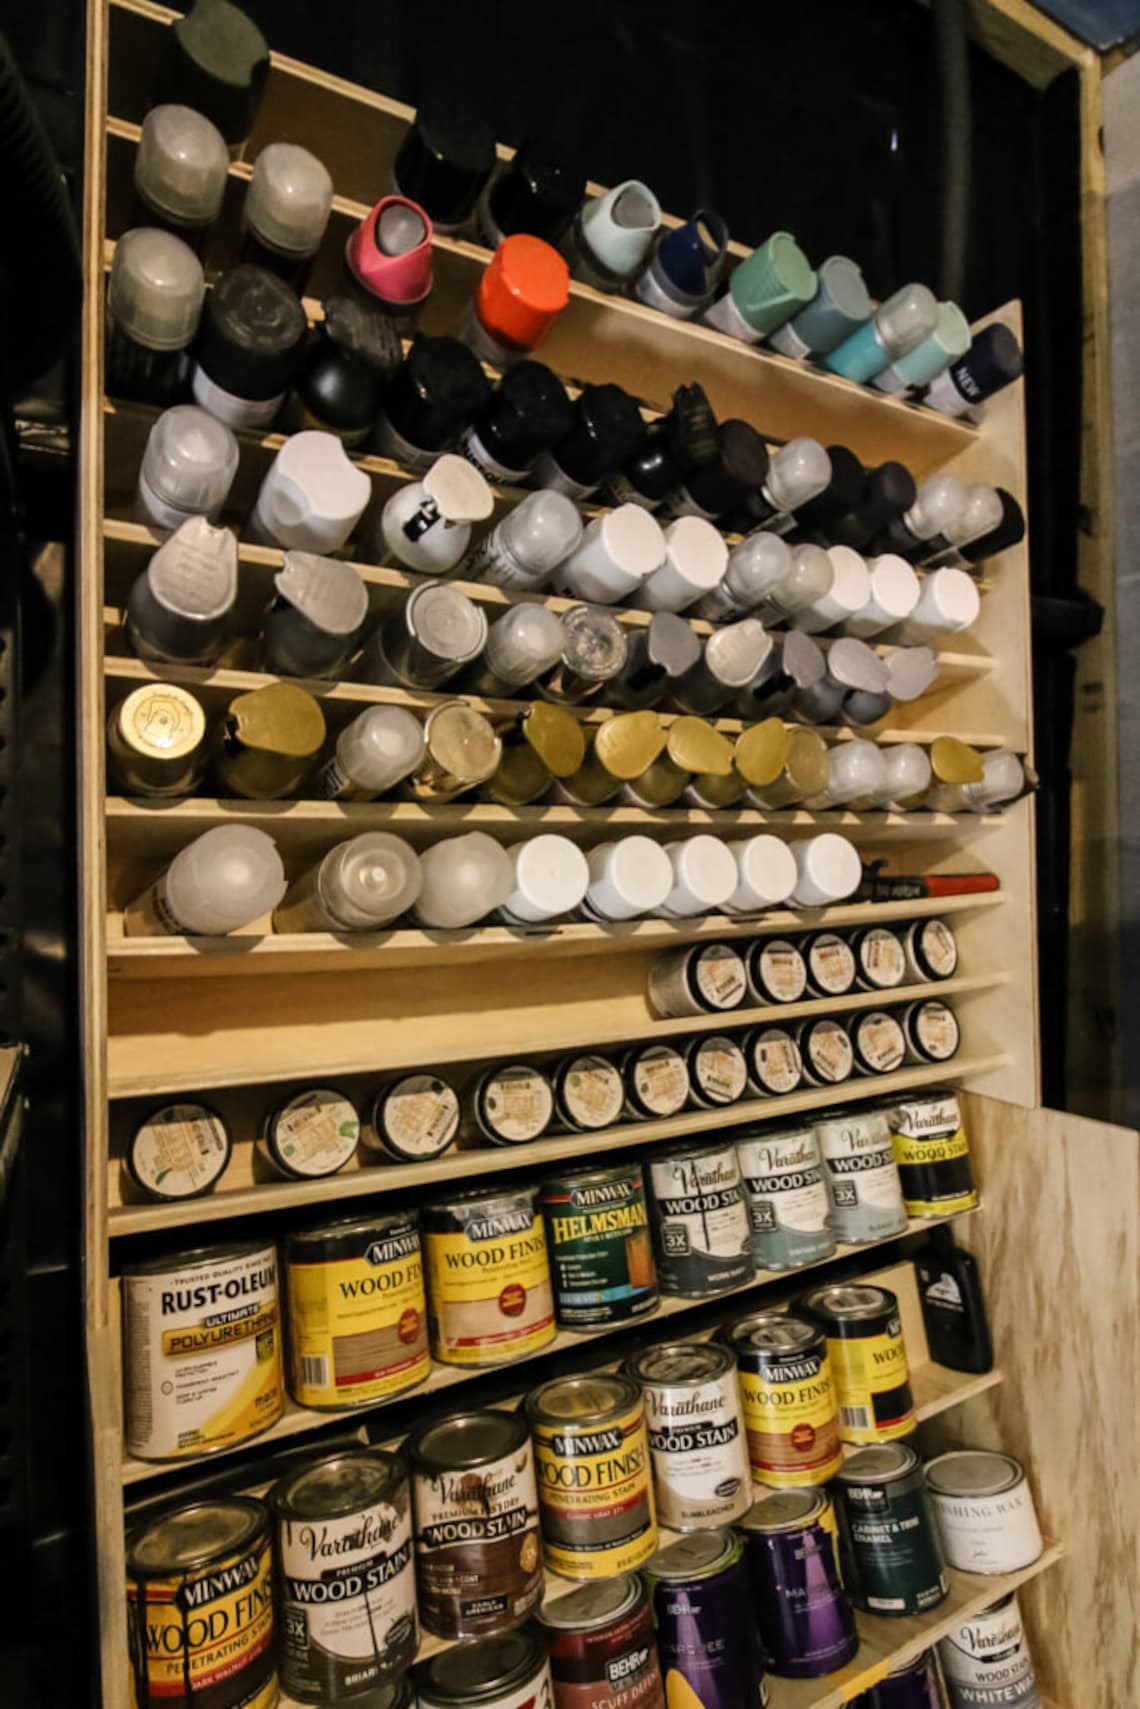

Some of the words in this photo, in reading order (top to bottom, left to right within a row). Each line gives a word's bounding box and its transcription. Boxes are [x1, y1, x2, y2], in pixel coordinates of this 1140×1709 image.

[956, 366, 980, 396] NEW
[834, 1154, 882, 1173] WOOD
[903, 1147, 946, 1161] WOOD
[752, 1173, 803, 1193] WOOD
[664, 1194, 719, 1215] WOOD
[835, 1191, 855, 1201] 3X
[552, 1202, 648, 1245] HELMSMAN
[753, 1211, 773, 1223] 3X
[666, 1234, 687, 1249] 3X
[444, 1247, 505, 1270] WOOD
[338, 1270, 404, 1300] WOOD
[743, 1389, 796, 1406] WOOD
[554, 1430, 621, 1456] MINWAX
[695, 1423, 737, 1448] STAIN
[542, 1462, 592, 1489] OOD
[428, 1521, 485, 1544] WOOD
[293, 1575, 362, 1603] WOOD
[365, 1543, 413, 1592] STAIN
[146, 1609, 230, 1655] WOOD
[287, 1619, 306, 1638] 3X
[608, 1651, 640, 1680] BEHR
[960, 1686, 1013, 1704] WHITE
